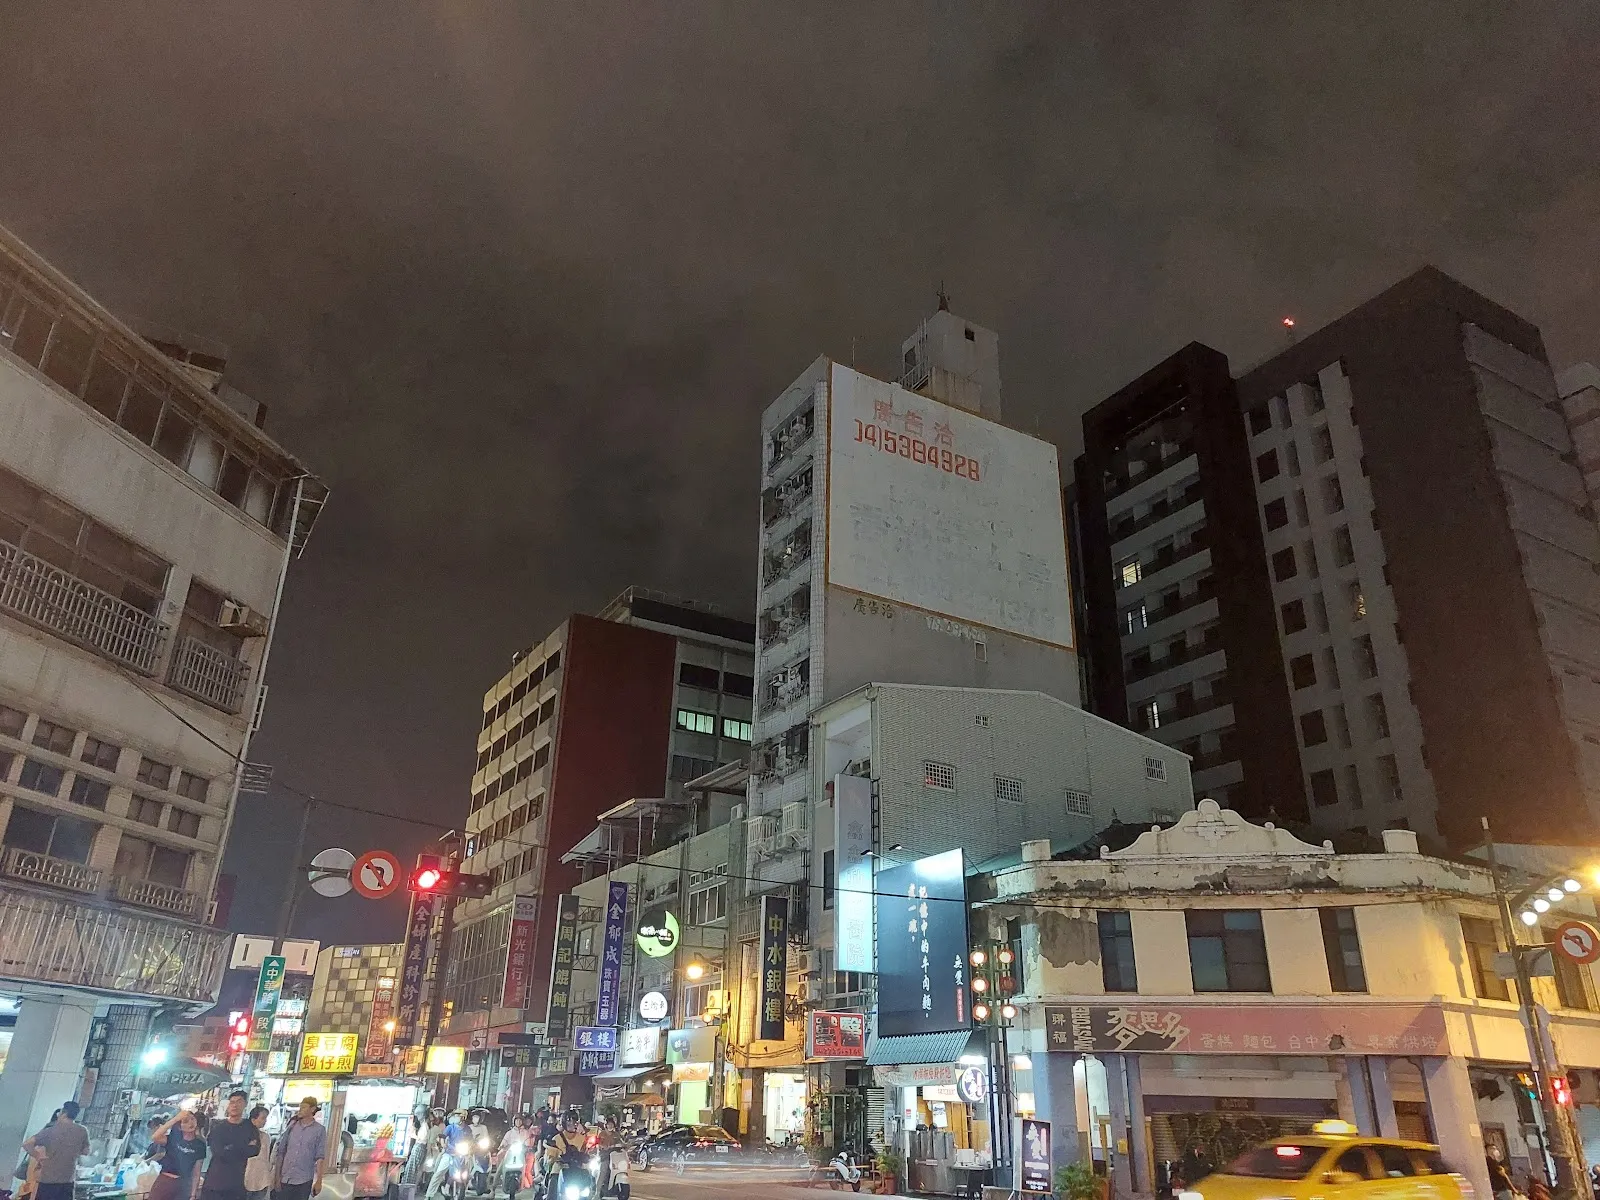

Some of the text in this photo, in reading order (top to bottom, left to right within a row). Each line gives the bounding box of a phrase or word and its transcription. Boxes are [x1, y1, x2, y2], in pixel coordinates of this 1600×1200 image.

[873, 399, 954, 448] 廣告洽
[511, 924, 529, 980] 新光銀行
[765, 914, 784, 1022] 中水銀樓
[256, 968, 278, 1029] 中華路一段
[305, 1036, 356, 1052] 臭豆腐
[579, 1031, 612, 1048] 銀樓
[1105, 1007, 1191, 1051] 麥思多
[1200, 1033, 1233, 1049] 蛋糕
[1243, 1034, 1277, 1049] 麵包
[1288, 1034, 1353, 1050] 台中
[301, 1056, 352, 1071] 蚵仔煎
[171, 1073, 205, 1085] PIZZA
